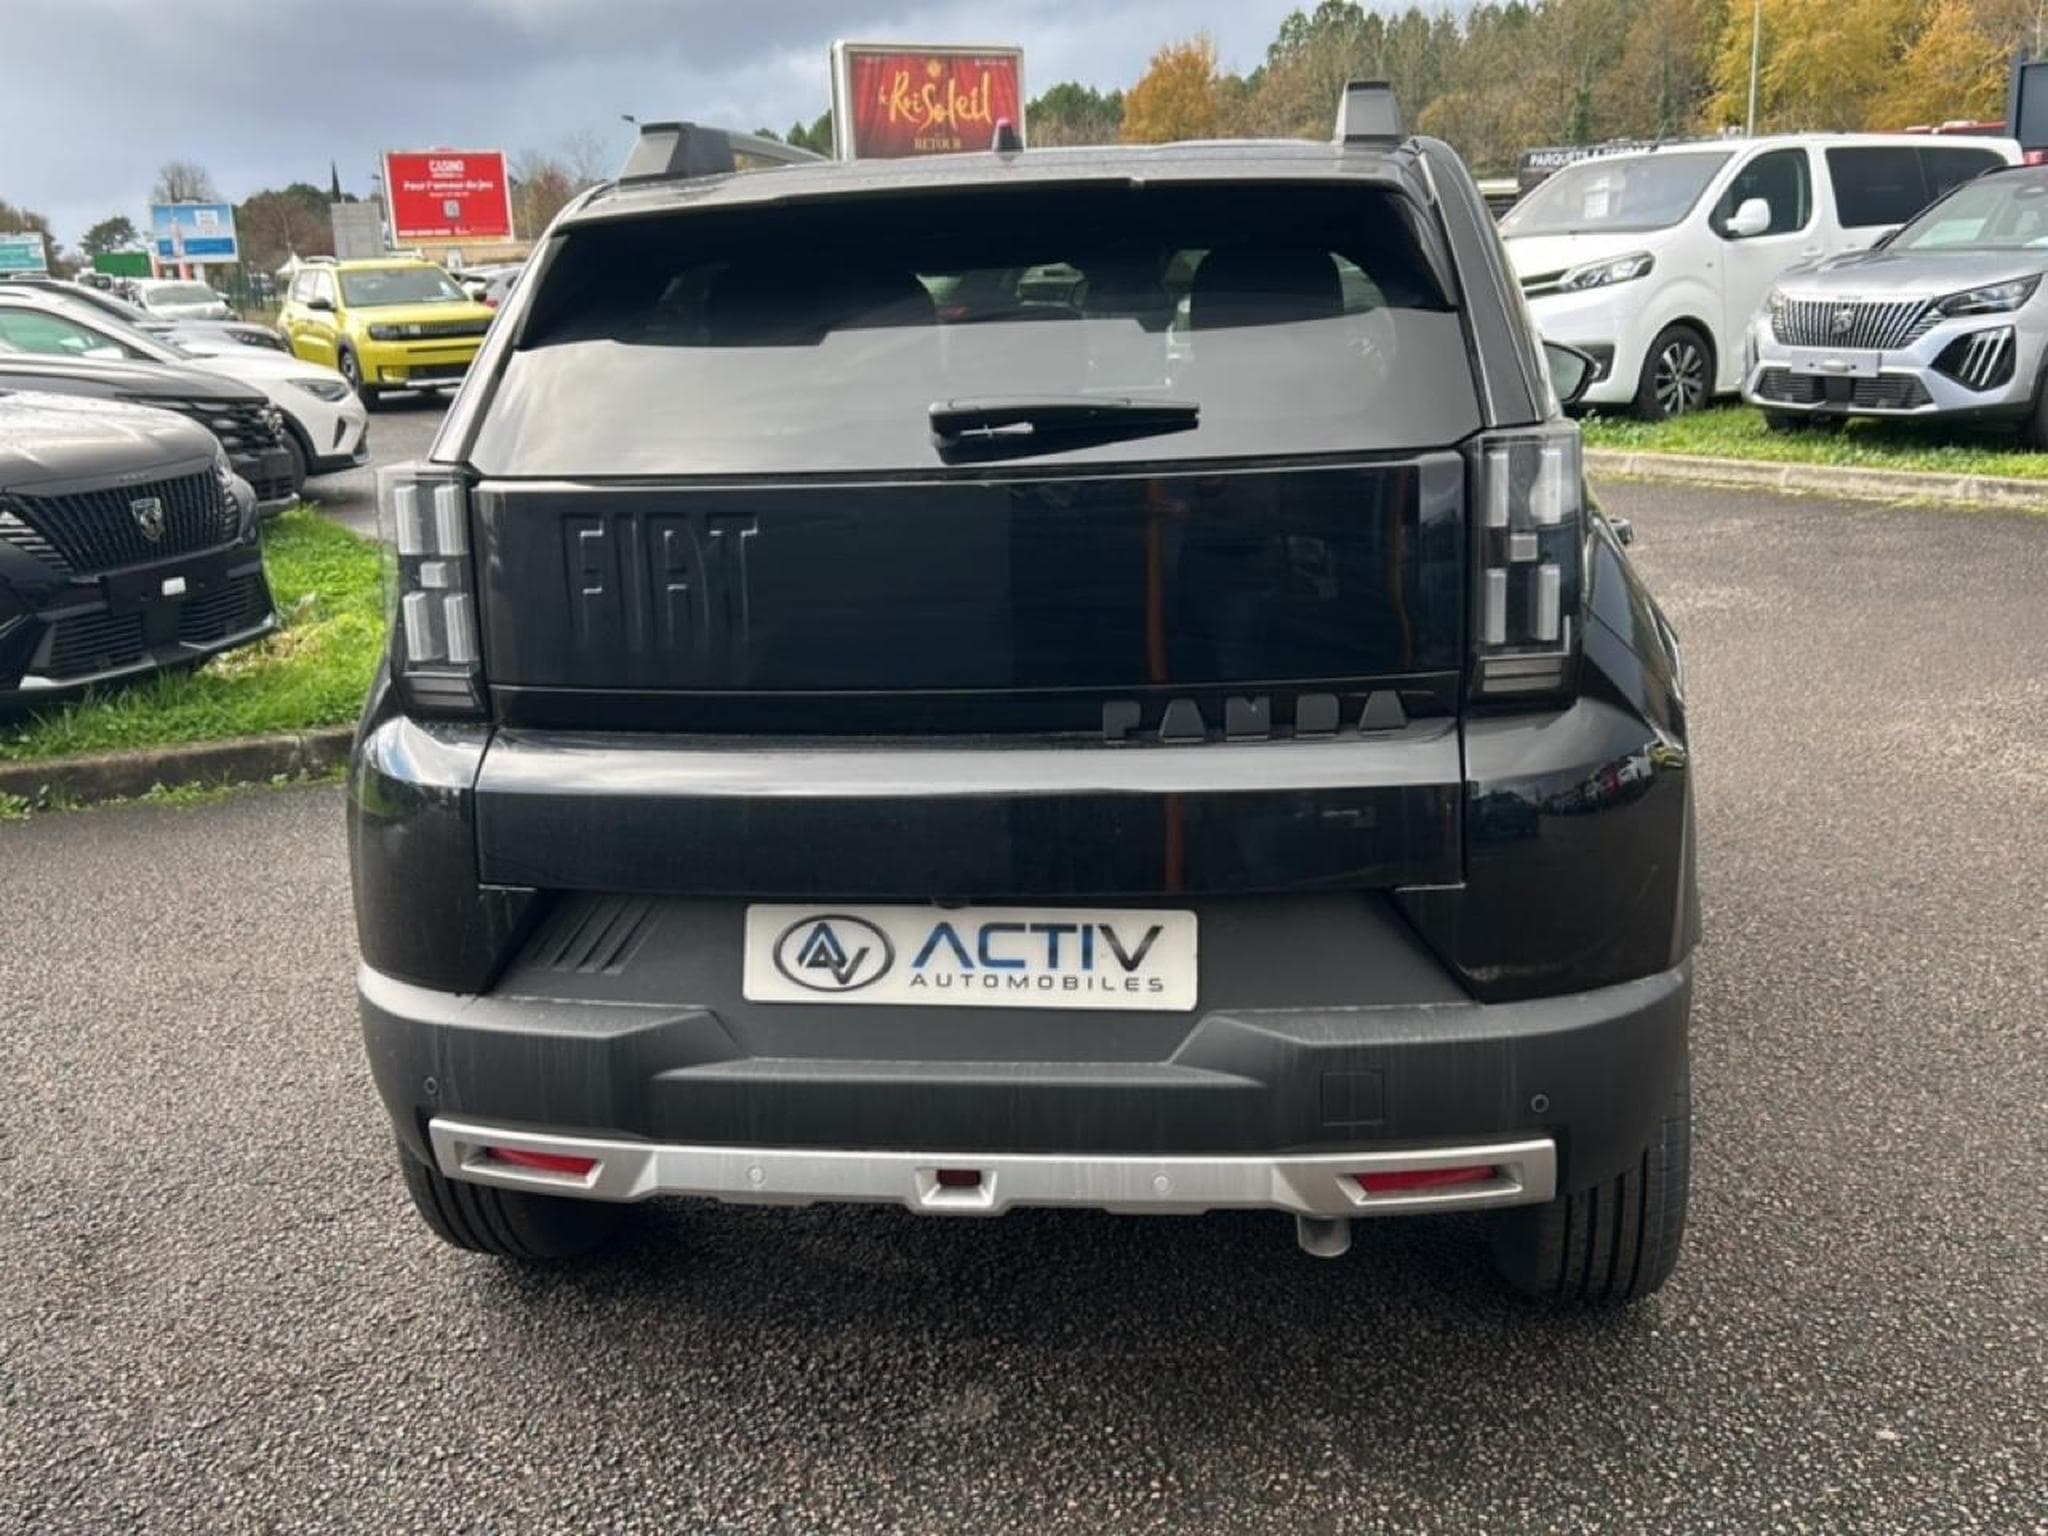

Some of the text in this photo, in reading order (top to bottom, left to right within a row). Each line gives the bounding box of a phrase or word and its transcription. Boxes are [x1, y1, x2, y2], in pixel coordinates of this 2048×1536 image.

[919, 71, 993, 132] Soleil
[429, 160, 464, 173] CASINO
[560, 512, 758, 652] FIAT
[1102, 690, 1408, 742] PANDA
[911, 920, 1165, 972] ACTIV
[909, 973, 1165, 993] AUTOMOBILES
